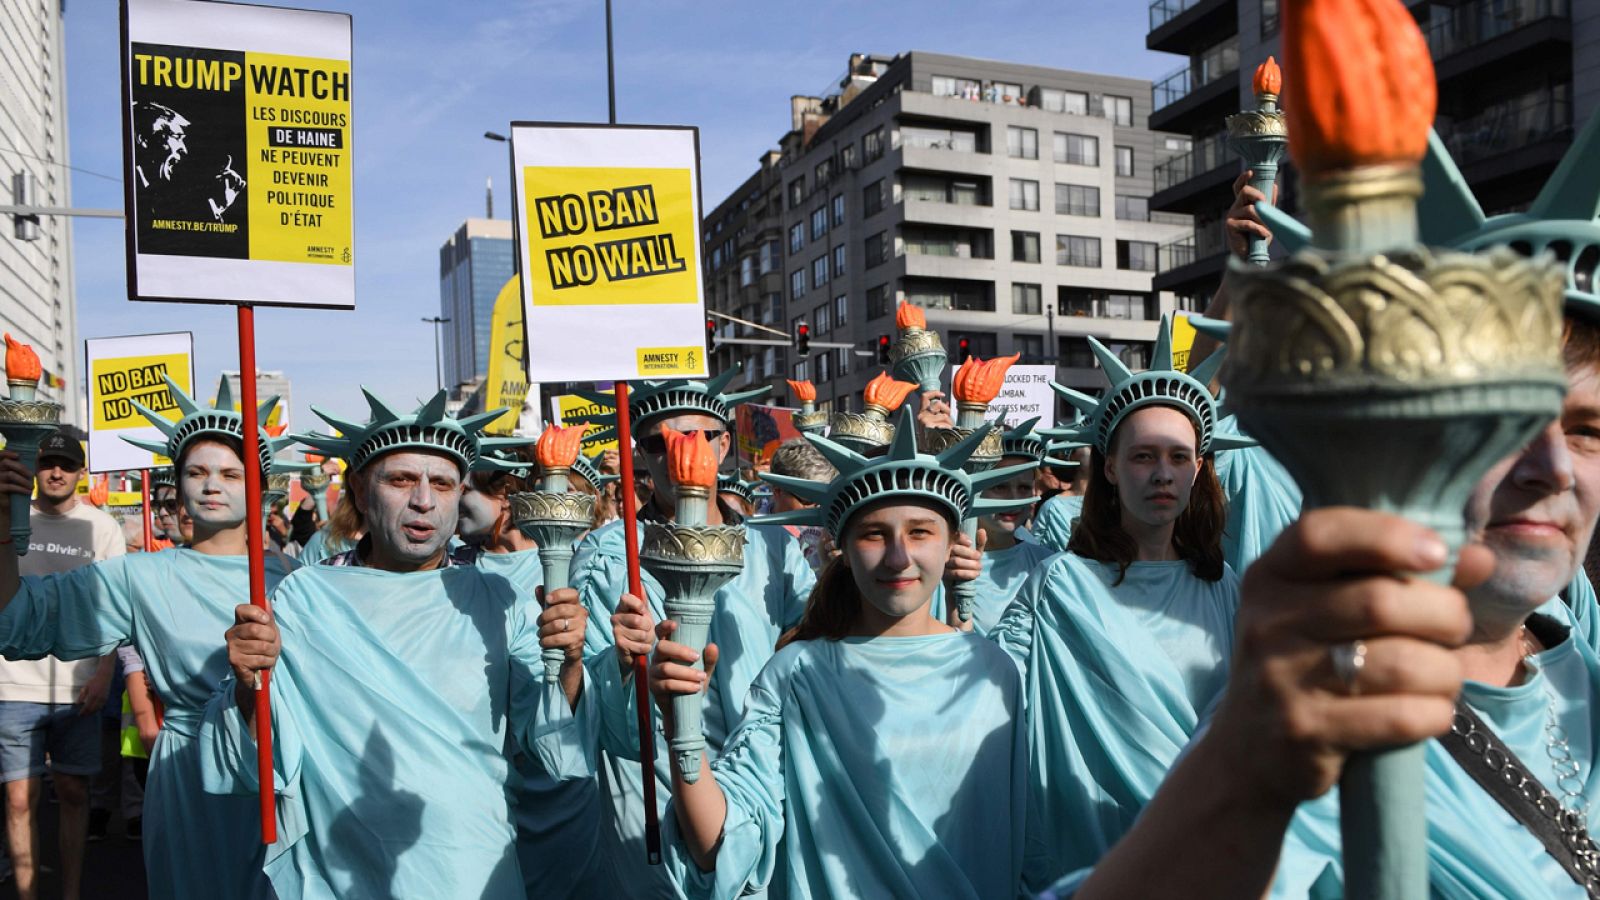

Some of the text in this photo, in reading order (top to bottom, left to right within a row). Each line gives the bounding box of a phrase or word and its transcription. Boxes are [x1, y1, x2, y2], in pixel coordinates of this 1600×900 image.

[135, 54, 350, 101] TRUMP WATCH
[253, 107, 346, 127] LES DISCOURS
[276, 129, 336, 147] DE HAINE
[261, 149, 340, 168] NE PEUVENT
[273, 171, 329, 187] DEVENIR
[267, 190, 335, 208] POLITIQUE
[281, 210, 323, 228] D'ÉTAT
[538, 187, 656, 236] NO BAN
[152, 219, 238, 233] AMNESTY.BE/TRUMP
[548, 236, 684, 287] NO WALL
[644, 353, 678, 363] AMNESTY
[100, 365, 166, 394] NO BAN
[501, 380, 526, 395] AMN
[1004, 374, 1047, 384] LOCKED THE
[104, 399, 131, 420] NO
[1020, 404, 1040, 413] MUST
[28, 543, 45, 551] ce
